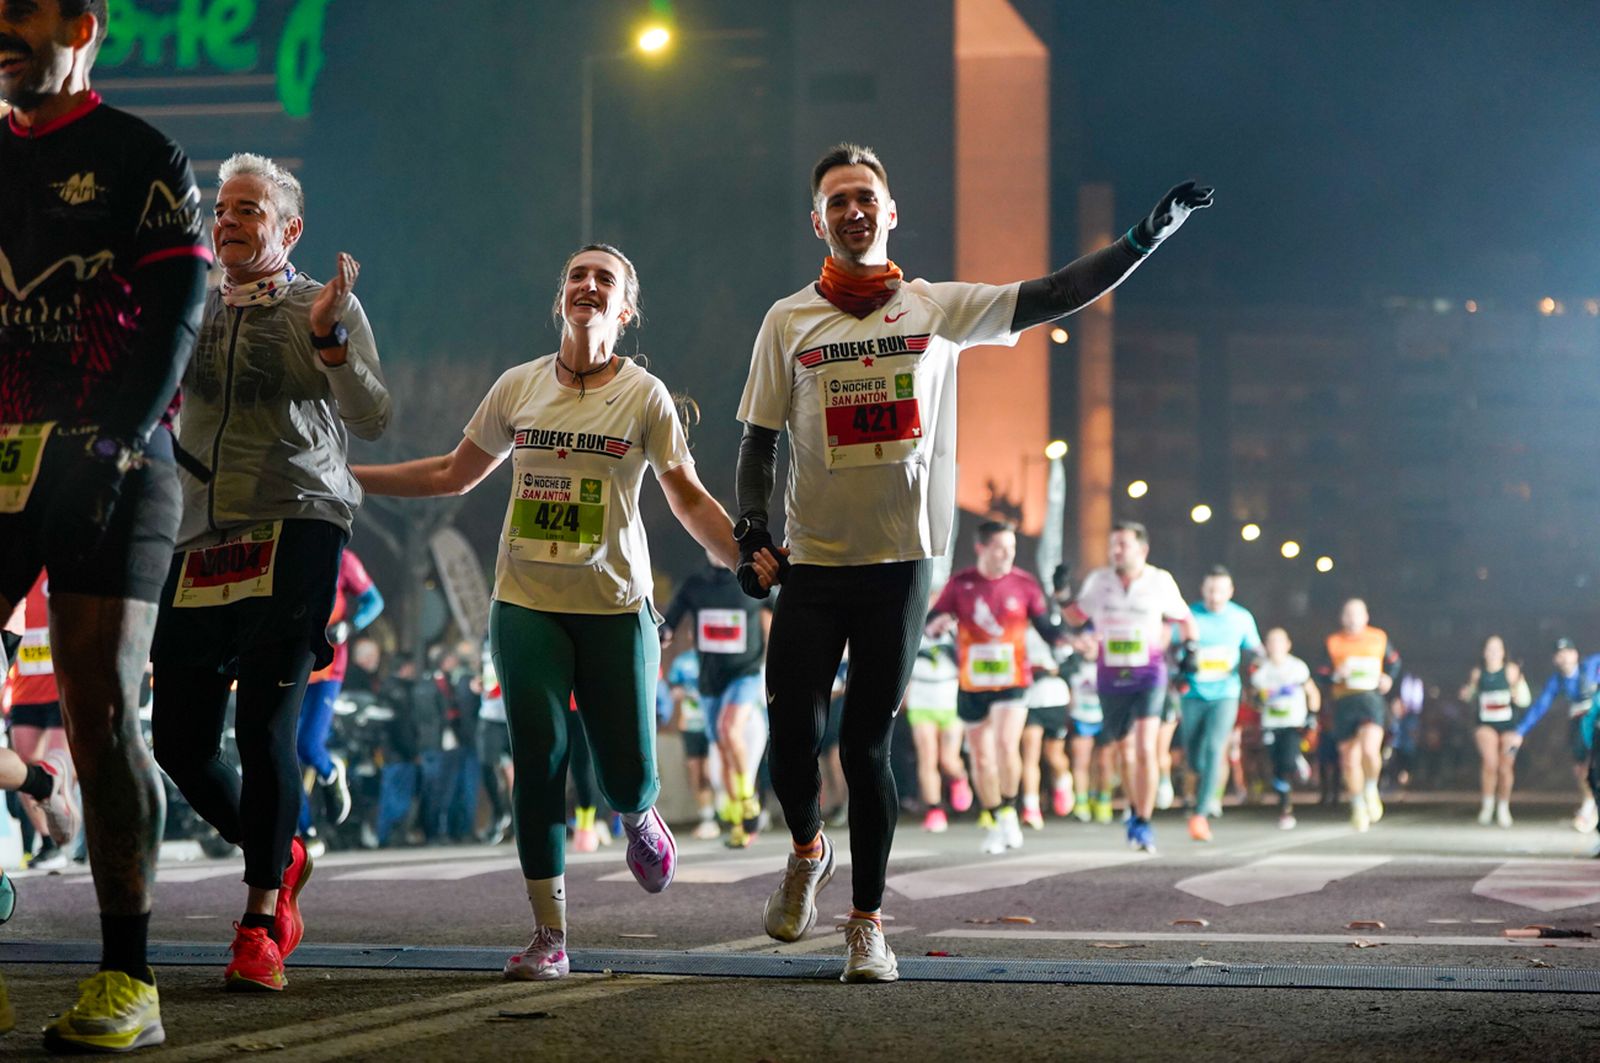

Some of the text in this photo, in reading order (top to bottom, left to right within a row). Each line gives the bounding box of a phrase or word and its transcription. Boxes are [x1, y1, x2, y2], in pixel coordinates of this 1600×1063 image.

[822, 335, 908, 360] TRUEKE RUN
[842, 381, 873, 393] NOCHE
[875, 380, 887, 390] DE
[832, 394, 852, 406] SAN
[853, 390, 888, 404] ANTÓN
[853, 404, 897, 433] 421
[525, 429, 606, 451] TRUEKE RUN
[534, 478, 560, 489] NOCHE
[560, 480, 572, 490] DE
[521, 488, 541, 500] SAN
[535, 502, 579, 532] 424
